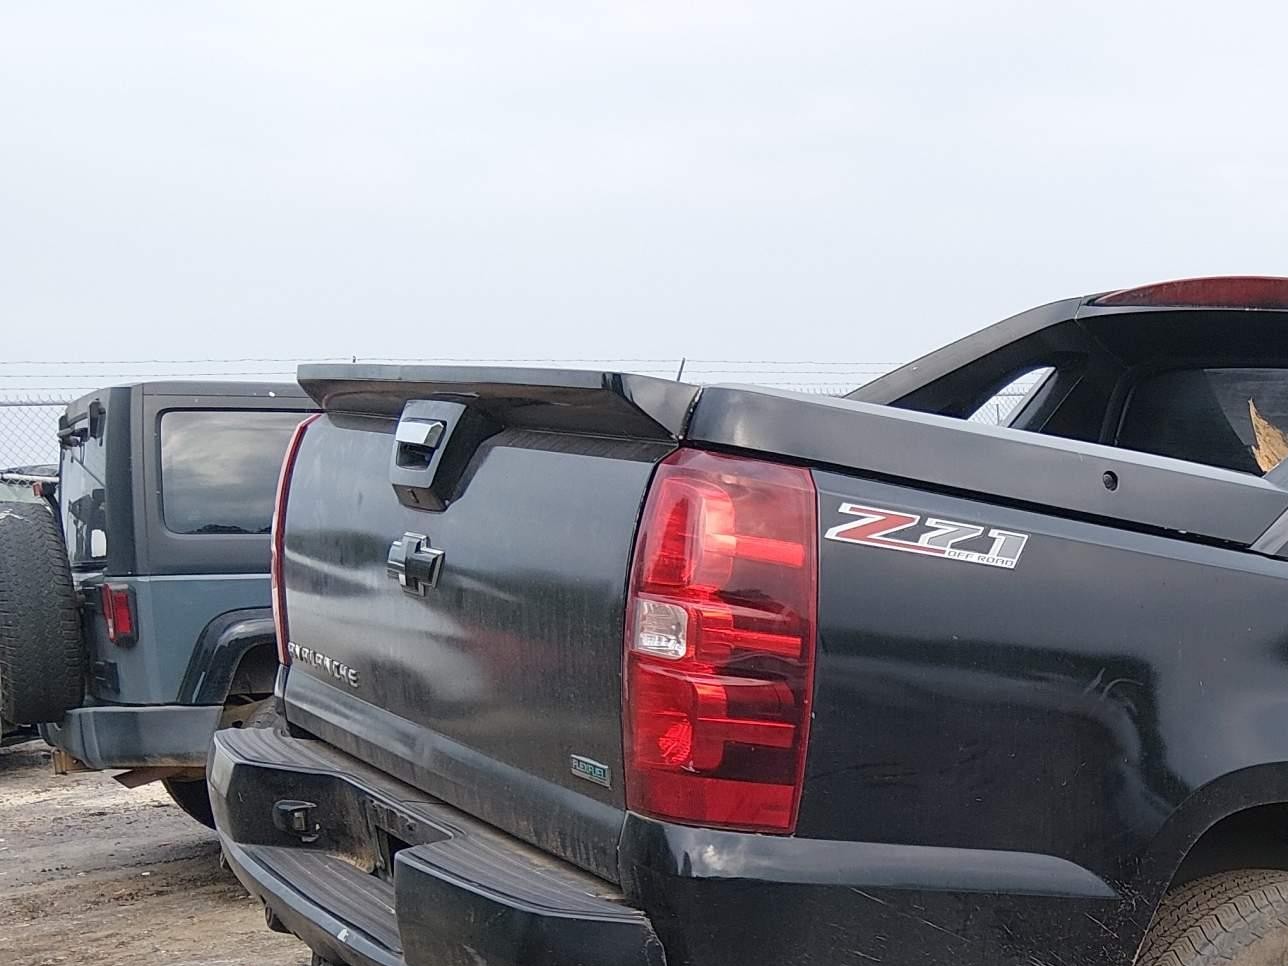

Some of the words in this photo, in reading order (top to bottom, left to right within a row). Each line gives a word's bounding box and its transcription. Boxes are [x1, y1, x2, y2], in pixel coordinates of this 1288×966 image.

[824, 502, 1028, 562] Z71
[947, 550, 974, 560] OFF
[977, 555, 1014, 567] ROAD
